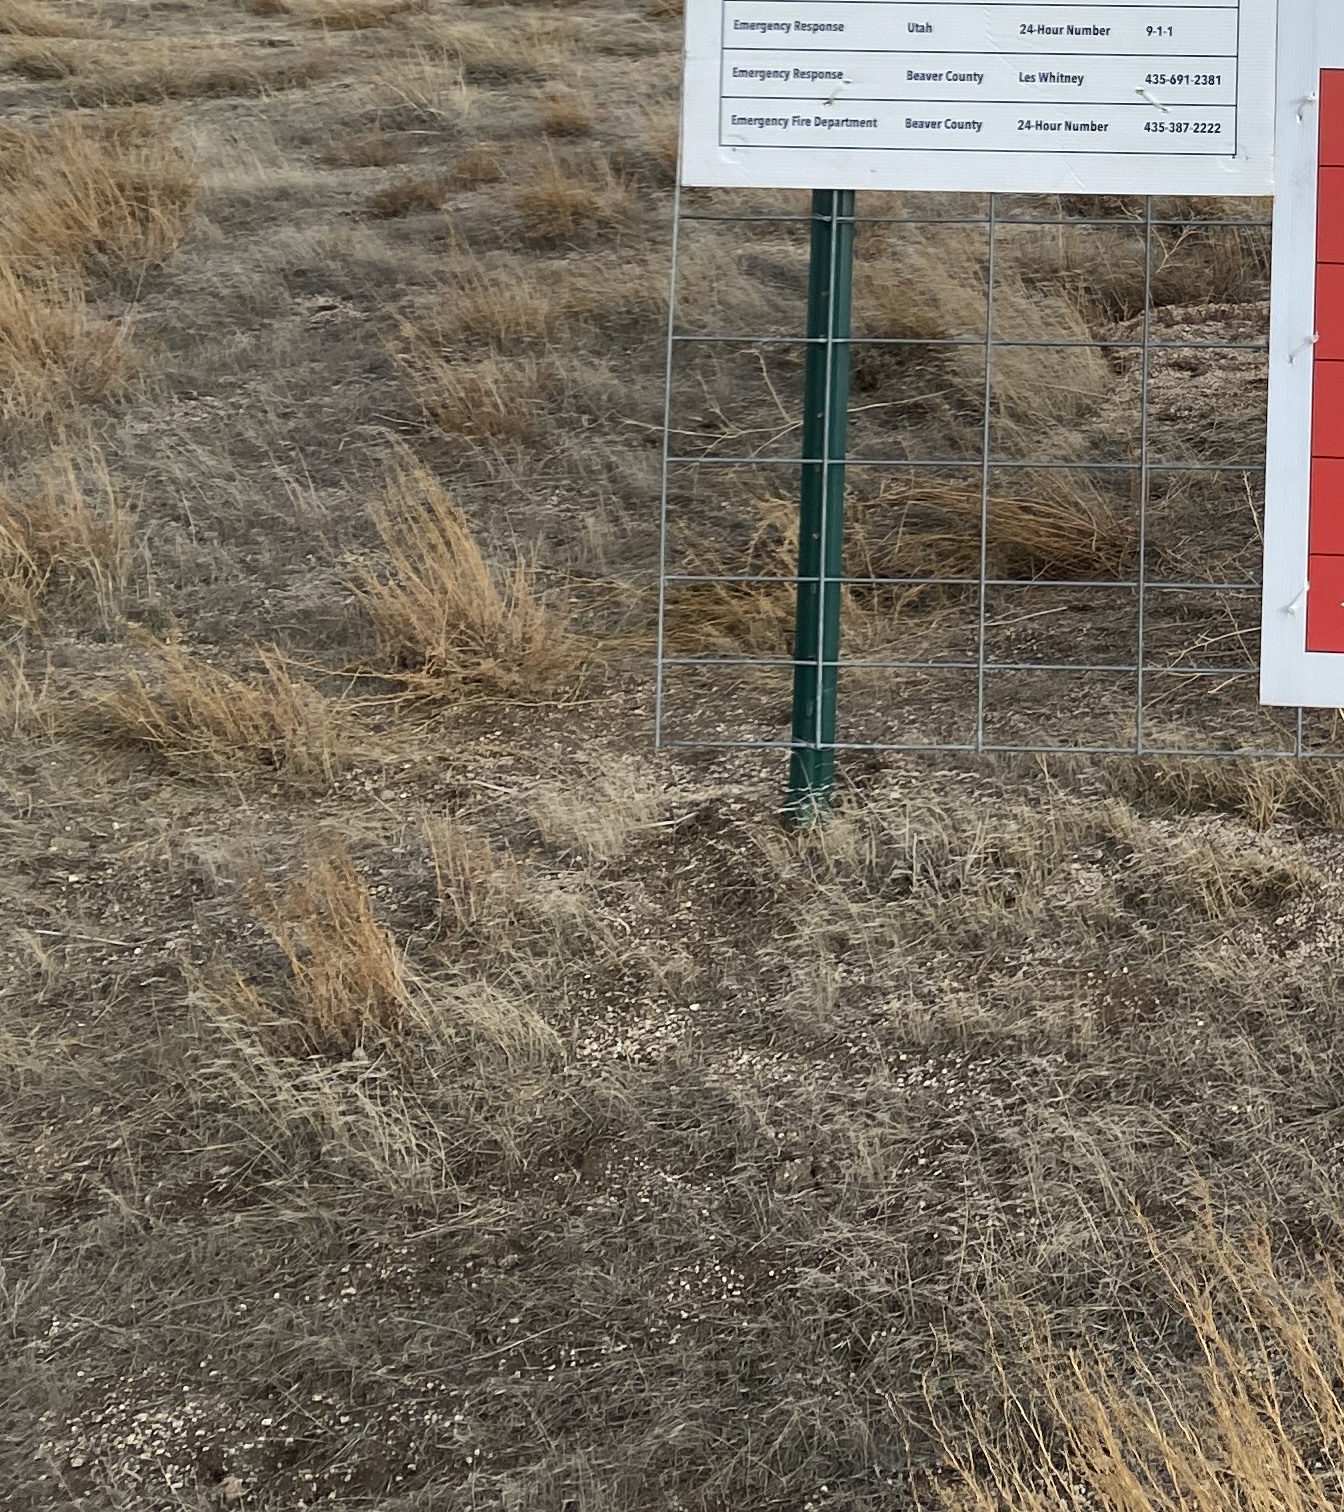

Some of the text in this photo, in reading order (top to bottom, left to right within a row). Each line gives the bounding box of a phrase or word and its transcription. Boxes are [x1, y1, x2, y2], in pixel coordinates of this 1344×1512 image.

[733, 19, 1173, 37] Emergency Response Utah 24-Hour Number 9-1-1
[732, 66, 1221, 87] Emergency Response Beaver County Les Whitney 435-691-2381
[731, 114, 1221, 134] Emergency Fire Department Beaver County 24-Hour Number 435-387-2222
